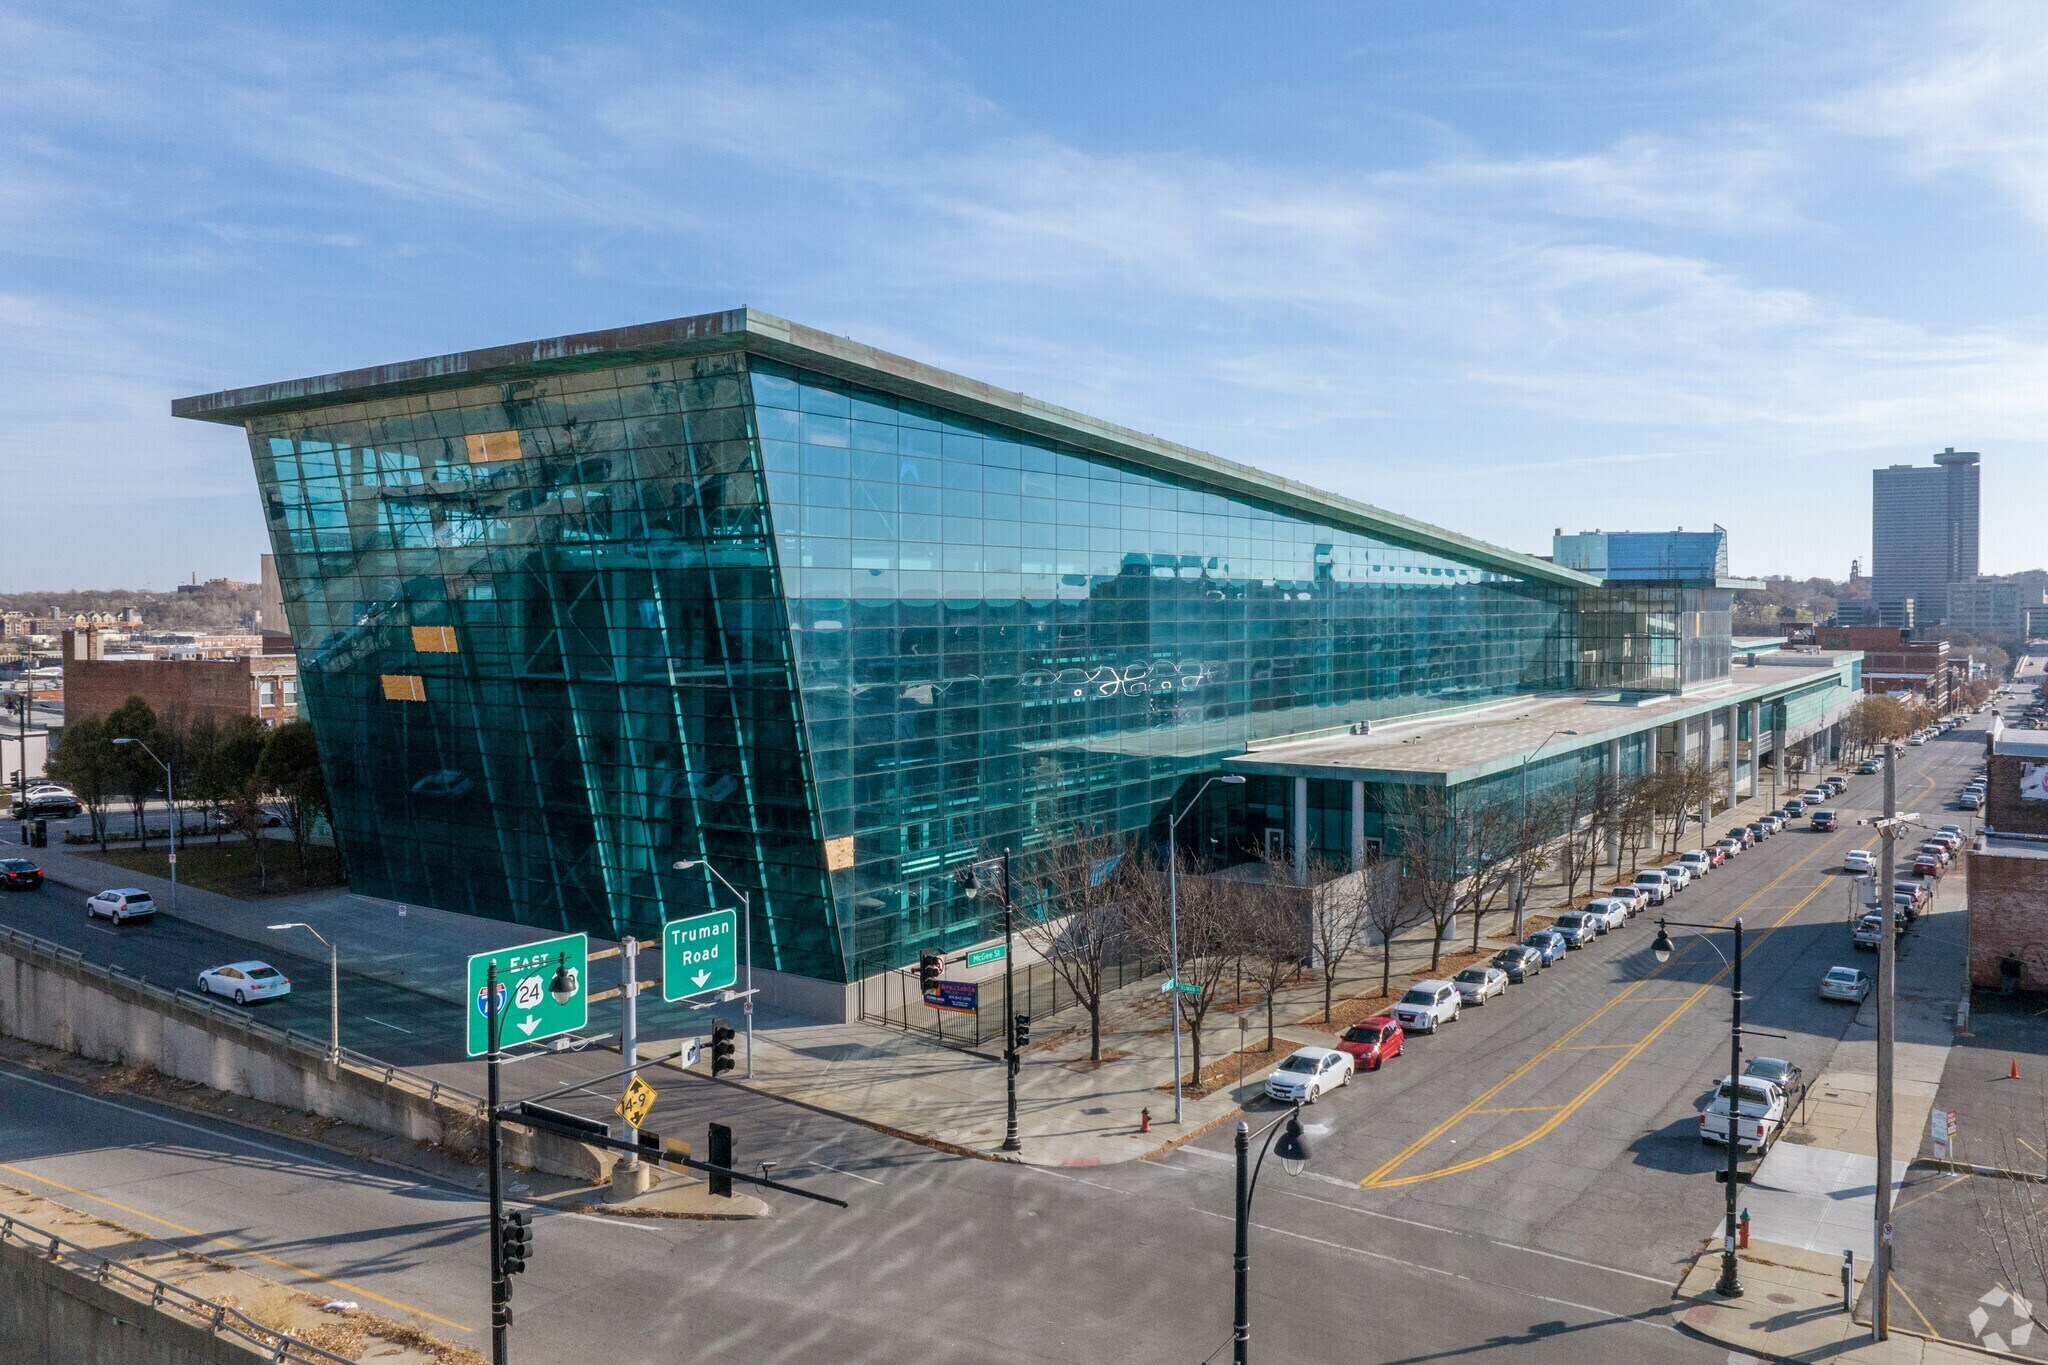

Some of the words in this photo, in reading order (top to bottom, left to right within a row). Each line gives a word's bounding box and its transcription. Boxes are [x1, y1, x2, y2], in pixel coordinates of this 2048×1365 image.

[672, 922, 729, 945] Truman
[683, 944, 718, 966] Road
[973, 951, 993, 963] McGee
[994, 949, 1001, 957] St
[519, 983, 540, 1003] 24
[941, 984, 976, 993] Available
[621, 1093, 646, 1115] 14-9
